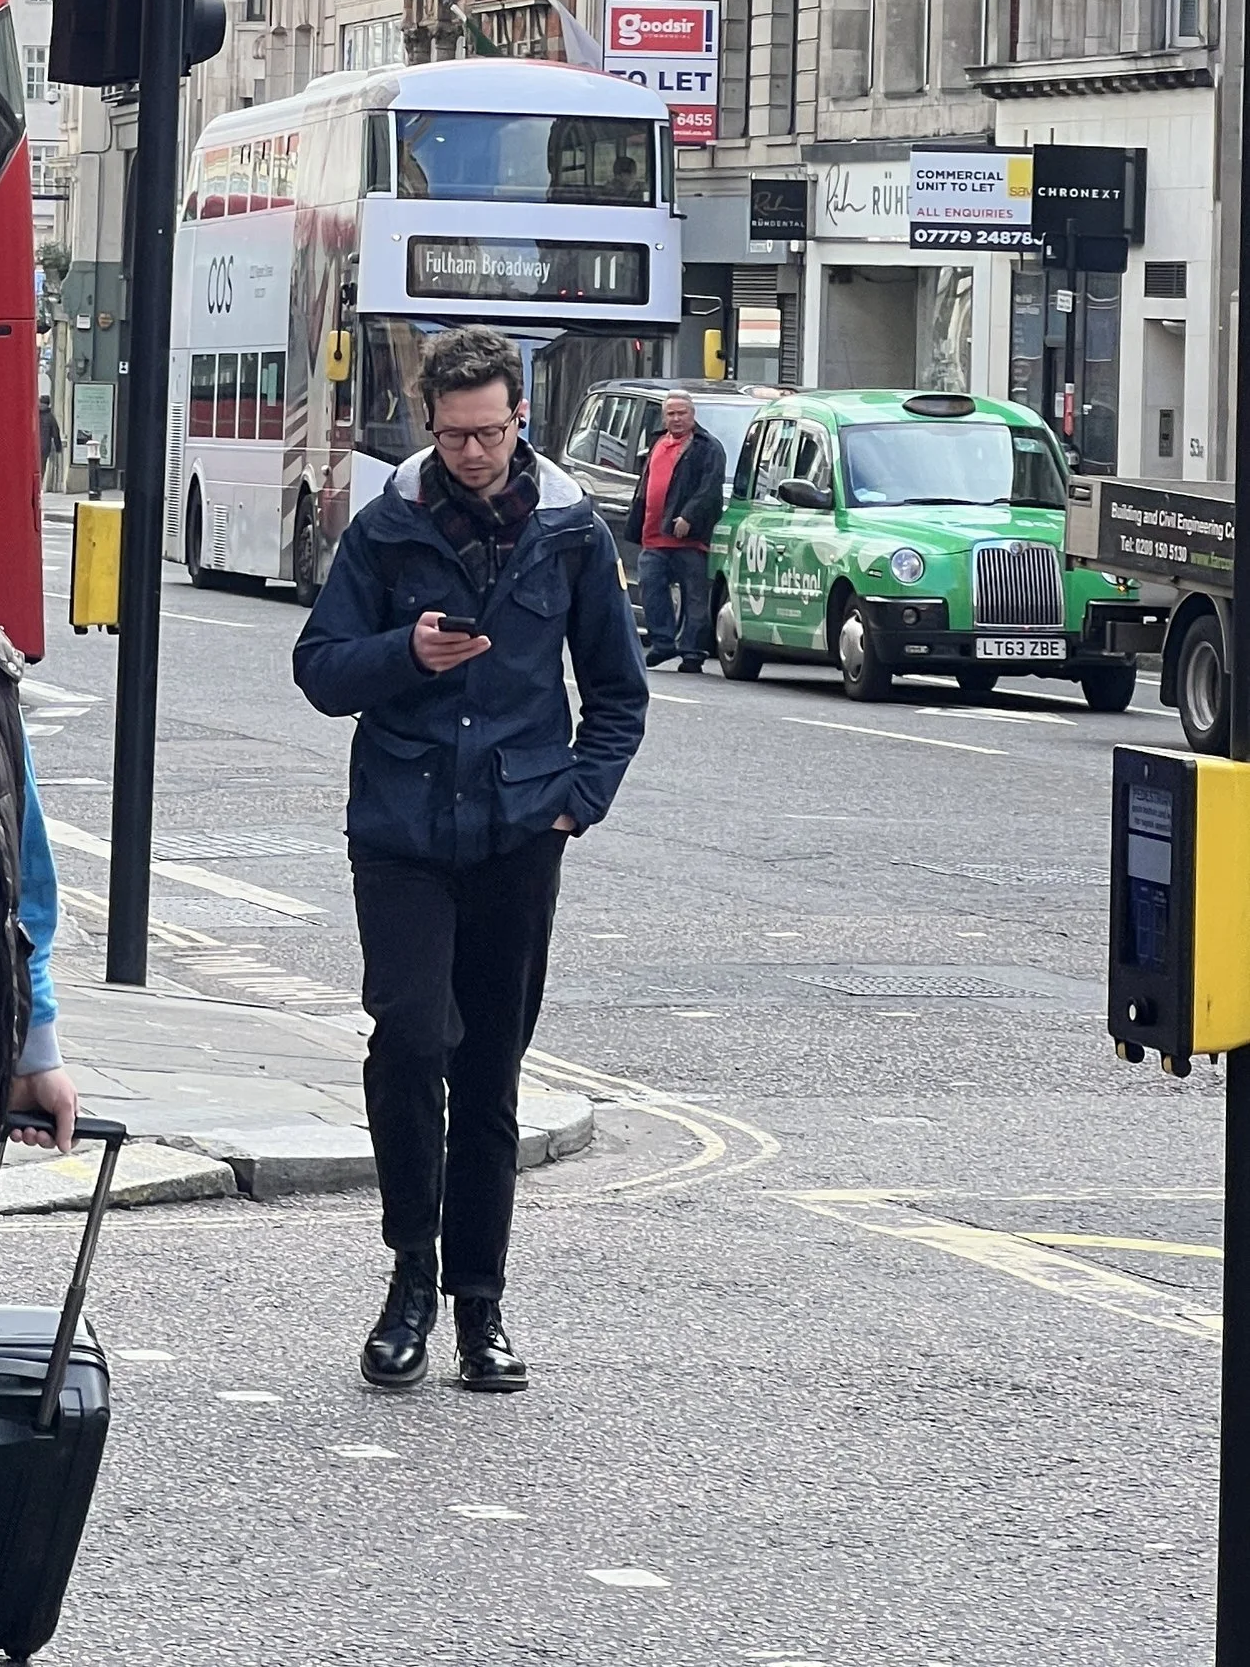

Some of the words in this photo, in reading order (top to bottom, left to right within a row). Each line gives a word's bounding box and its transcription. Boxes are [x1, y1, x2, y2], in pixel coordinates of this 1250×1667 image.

[618, 13, 695, 46] goodsir
[658, 71, 712, 92] LET
[676, 113, 712, 127] 6455
[916, 170, 1004, 182] COMMERCIAL
[916, 181, 948, 192] UNIT
[950, 182, 968, 192] TO
[971, 183, 995, 193] LET
[1037, 186, 1121, 200] CHRONEXT
[917, 207, 940, 217] ALL
[945, 208, 1014, 219] ENQUIRIES
[914, 229, 972, 244] 07779
[426, 251, 476, 274] Fulham
[482, 253, 551, 284] Broadway
[593, 255, 616, 290] 11
[207, 254, 234, 315] COS
[1111, 502, 1143, 527] Building
[1143, 509, 1158, 525] and
[1159, 510, 1177, 529] Civil
[1177, 513, 1224, 541] Engineering
[1120, 535, 1135, 552] Tel:
[1135, 539, 1154, 556] 0208
[1154, 543, 1168, 559] 150
[1169, 544, 1188, 563] 5130
[775, 565, 801, 595] Let's
[801, 568, 823, 605] go!
[983, 641, 1025, 656] LT63
[1029, 641, 1060, 656] ZBE
